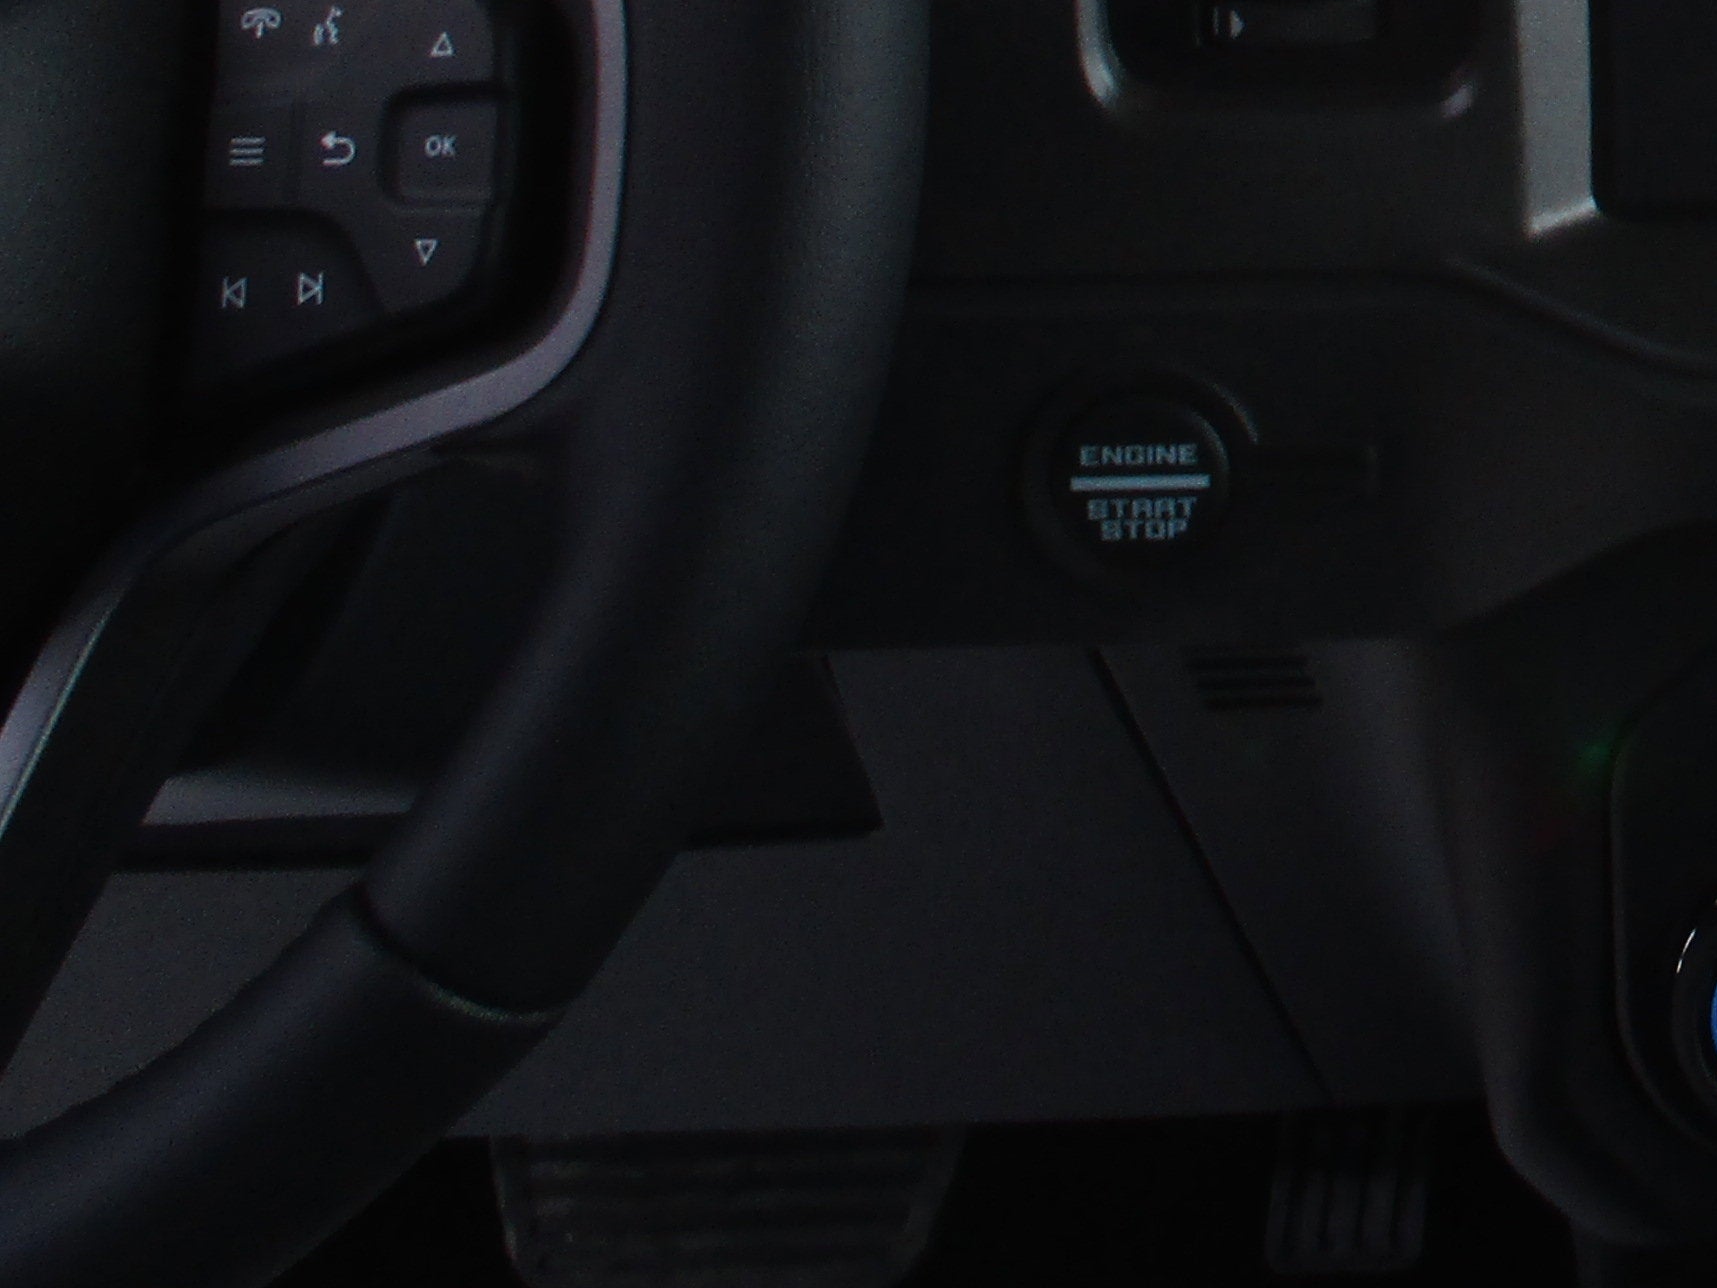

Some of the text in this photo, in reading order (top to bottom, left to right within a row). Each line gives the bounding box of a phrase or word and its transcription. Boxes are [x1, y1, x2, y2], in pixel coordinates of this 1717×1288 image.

[423, 134, 457, 159] OK
[1079, 442, 1200, 466] ENGINE
[1087, 495, 1198, 521] START
[1101, 518, 1189, 541] STOP
